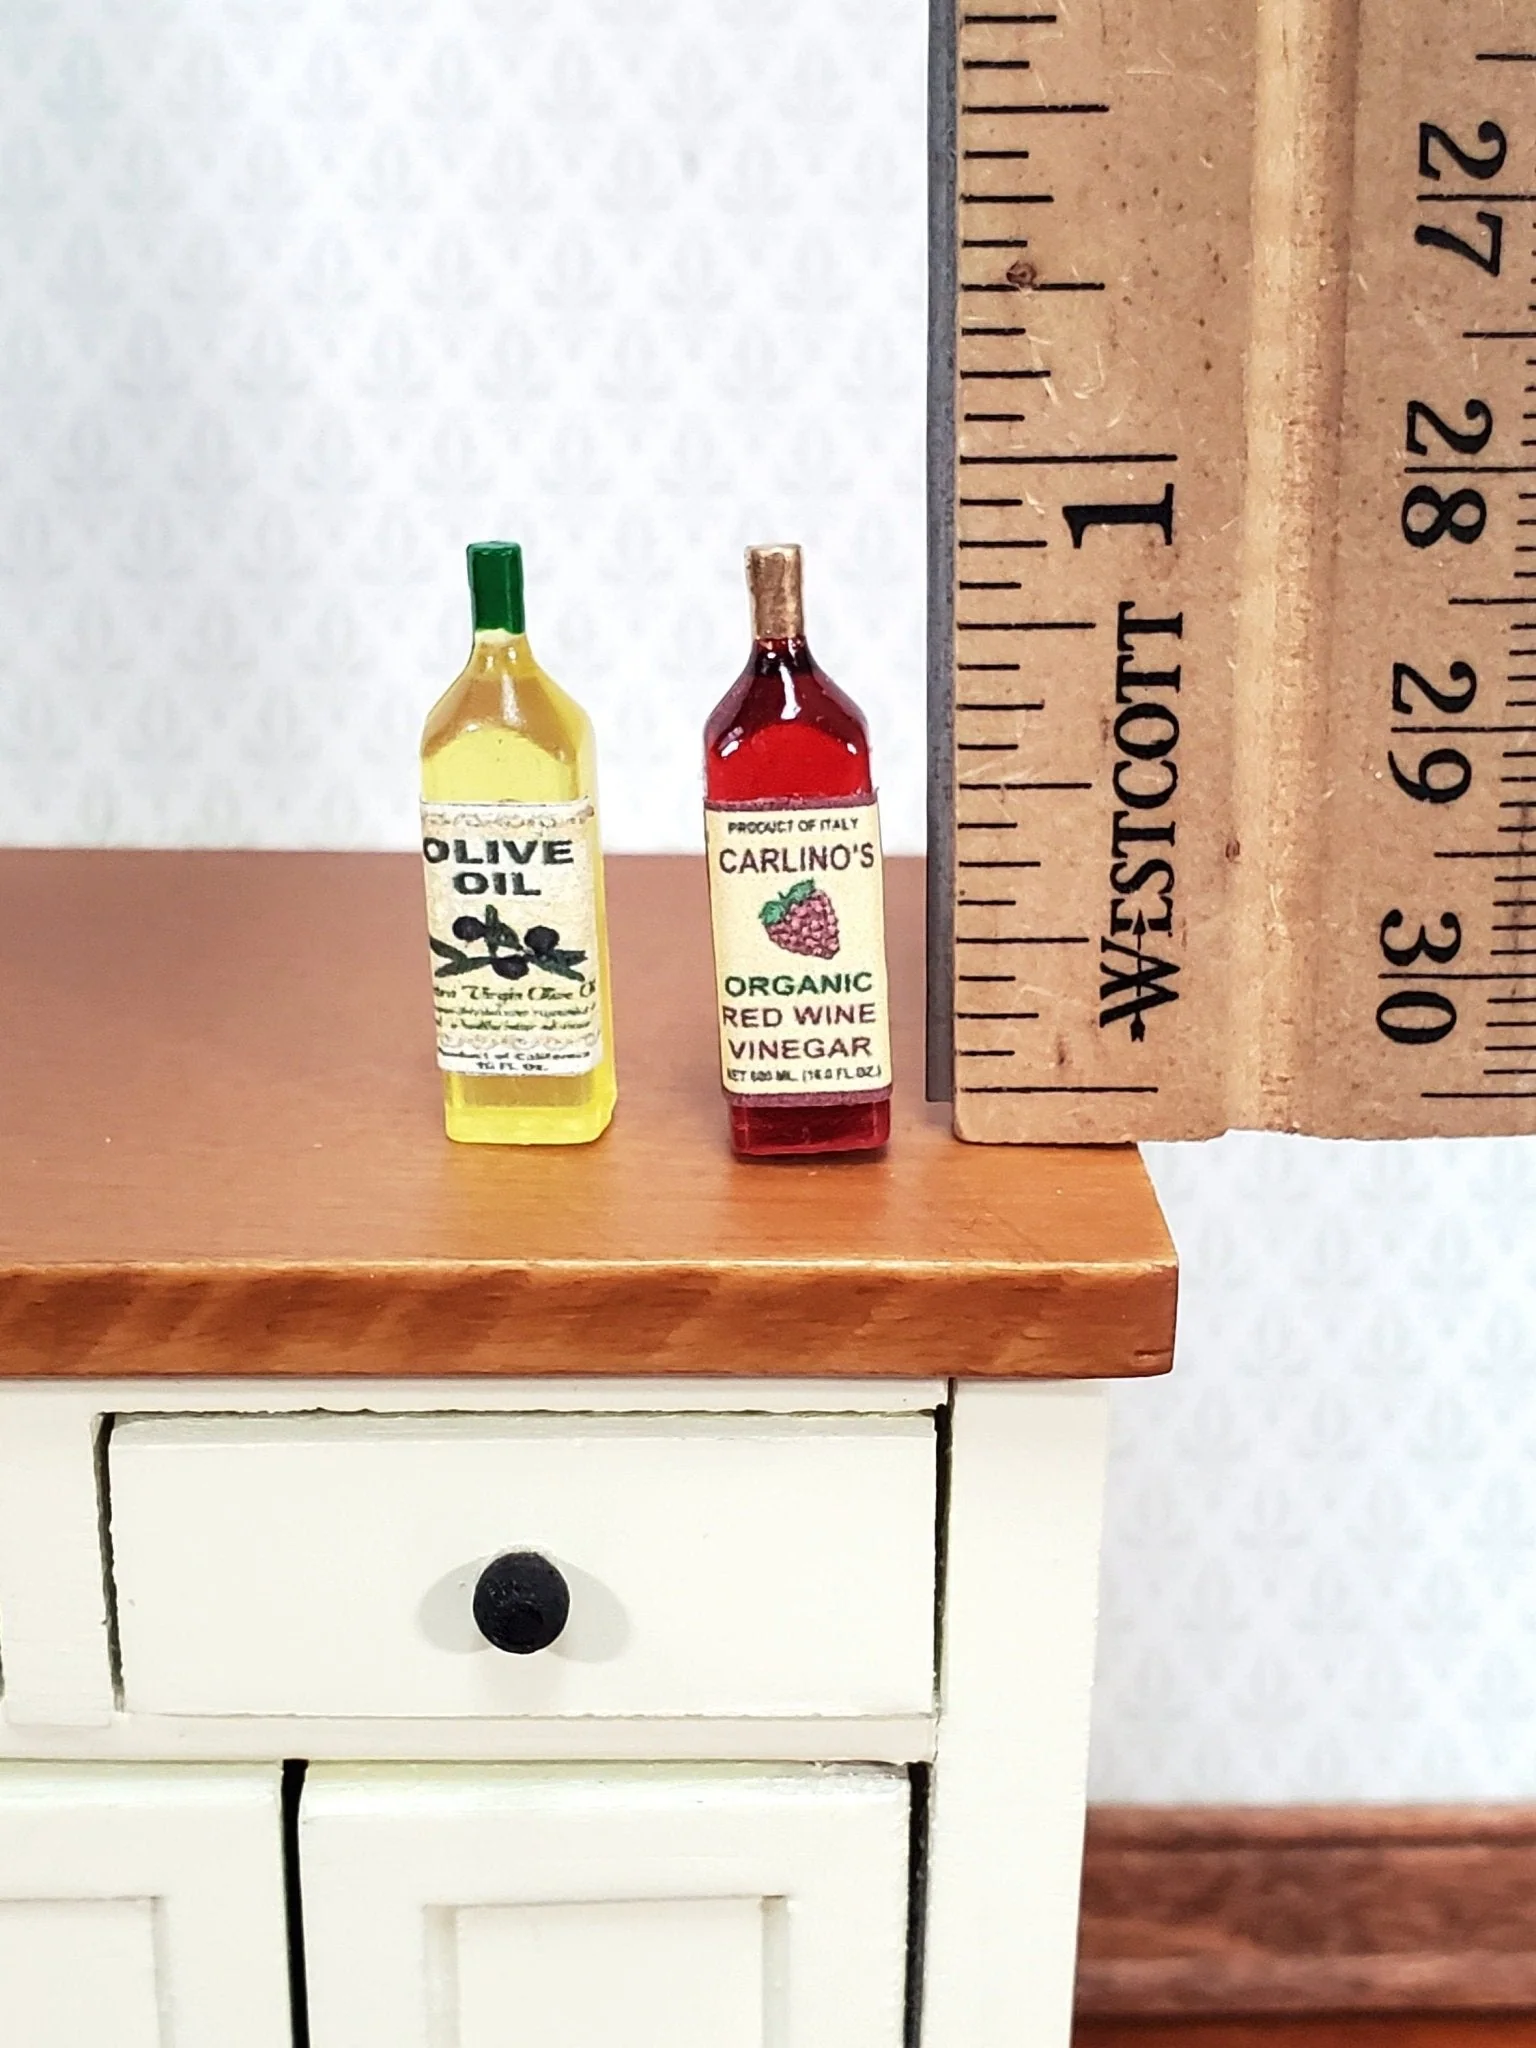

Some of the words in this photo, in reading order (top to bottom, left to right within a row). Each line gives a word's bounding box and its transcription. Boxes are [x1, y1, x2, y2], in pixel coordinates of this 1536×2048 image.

[1415, 120, 1508, 278] 27
[1401, 399, 1494, 549] 28
[1062, 483, 1175, 549] 1
[1388, 660, 1478, 806] 29
[728, 820, 794, 835] PRODUCT
[798, 819, 817, 832] OF
[820, 818, 859, 832] ITALY
[1099, 601, 1184, 1032] WESTCOTT
[423, 837, 574, 865] OLIVE
[719, 842, 875, 874] CARLINO'S
[452, 872, 542, 896] OIL
[724, 972, 873, 998] ORGANIC
[1376, 908, 1464, 1045] 30
[722, 1005, 783, 1028] RED
[793, 1003, 876, 1026] WINE
[728, 1037, 873, 1061] VINEGAR
